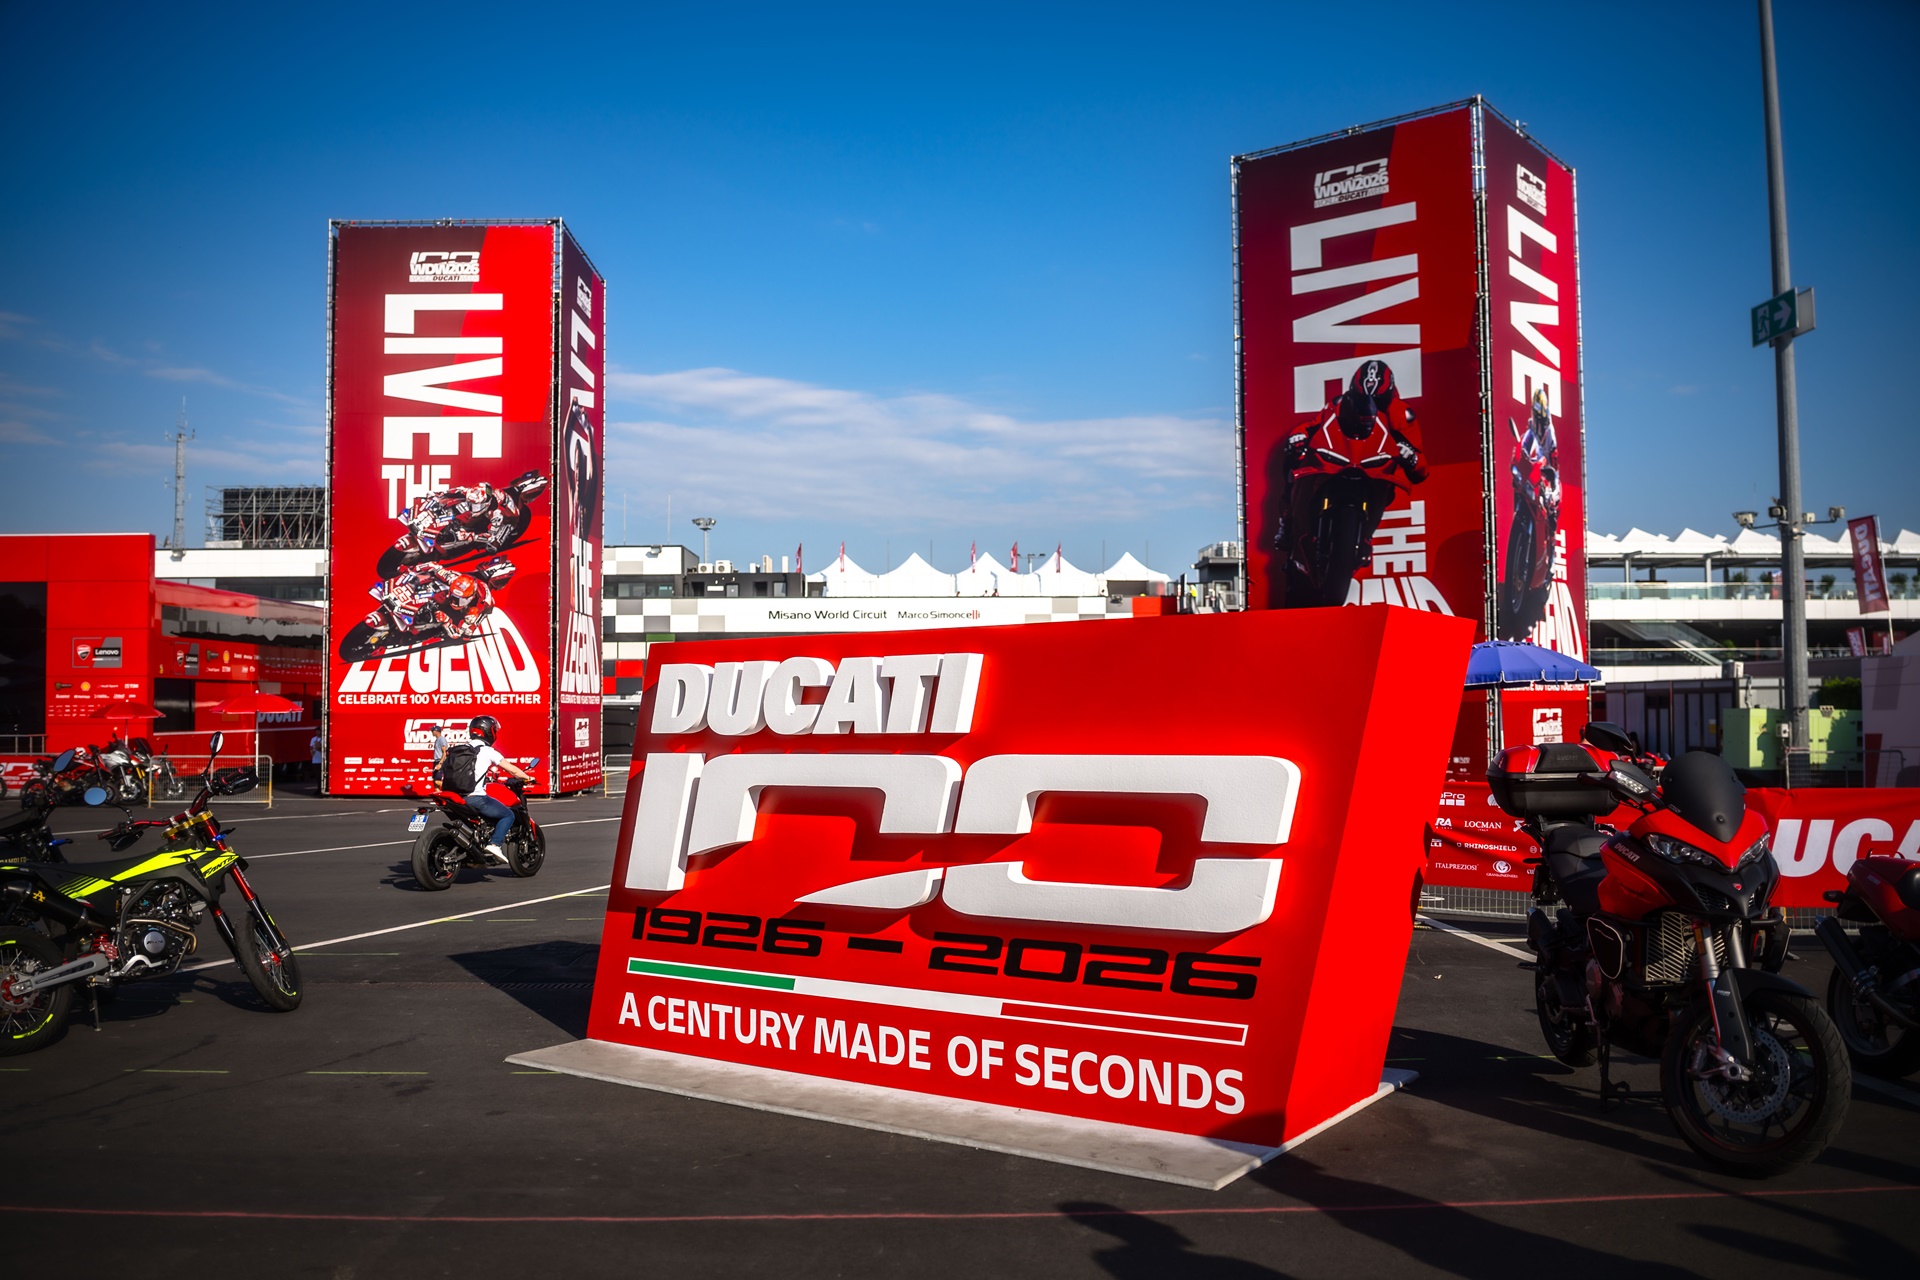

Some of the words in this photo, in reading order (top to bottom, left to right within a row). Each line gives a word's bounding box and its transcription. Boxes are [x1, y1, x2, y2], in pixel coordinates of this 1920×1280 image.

[1314, 171, 1389, 200] WDW2026
[1338, 191, 1368, 202] DUCATI
[410, 263, 480, 275] WDW2026
[1290, 201, 1423, 414] LIVE
[1507, 204, 1562, 418] LIVE
[383, 293, 503, 460] LIVE
[1372, 500, 1427, 575] THE
[1552, 529, 1568, 580] THE
[1854, 523, 1882, 602] DUCATI
[572, 534, 593, 615] THE
[768, 610, 812, 620] Misano
[814, 610, 849, 620] World
[852, 609, 887, 620] Circuit
[898, 610, 929, 619] Marco
[930, 609, 981, 620] Simoncelli
[95, 648, 119, 656] Lenovo
[560, 611, 600, 694] LEGEND
[338, 694, 407, 705] CELEBRATE
[410, 694, 430, 704] 100
[432, 694, 472, 705] YEARS
[474, 693, 541, 704] TOGETHER
[651, 653, 984, 736] DUCATI
[625, 752, 1302, 933] 100
[1464, 821, 1502, 829] LOCMAN
[1464, 842, 1517, 852] RHINOSHIELD
[1435, 862, 1478, 871] ITALPREZIOSI
[1614, 842, 1640, 862] DUCATI
[632, 906, 826, 957] 1926
[928, 931, 1262, 1000] 2026
[618, 992, 641, 1028] A
[647, 995, 805, 1051] CENTURY
[813, 1017, 932, 1071] MADE
[946, 1035, 1004, 1080] OF
[1014, 1043, 1246, 1115] SECONDS
